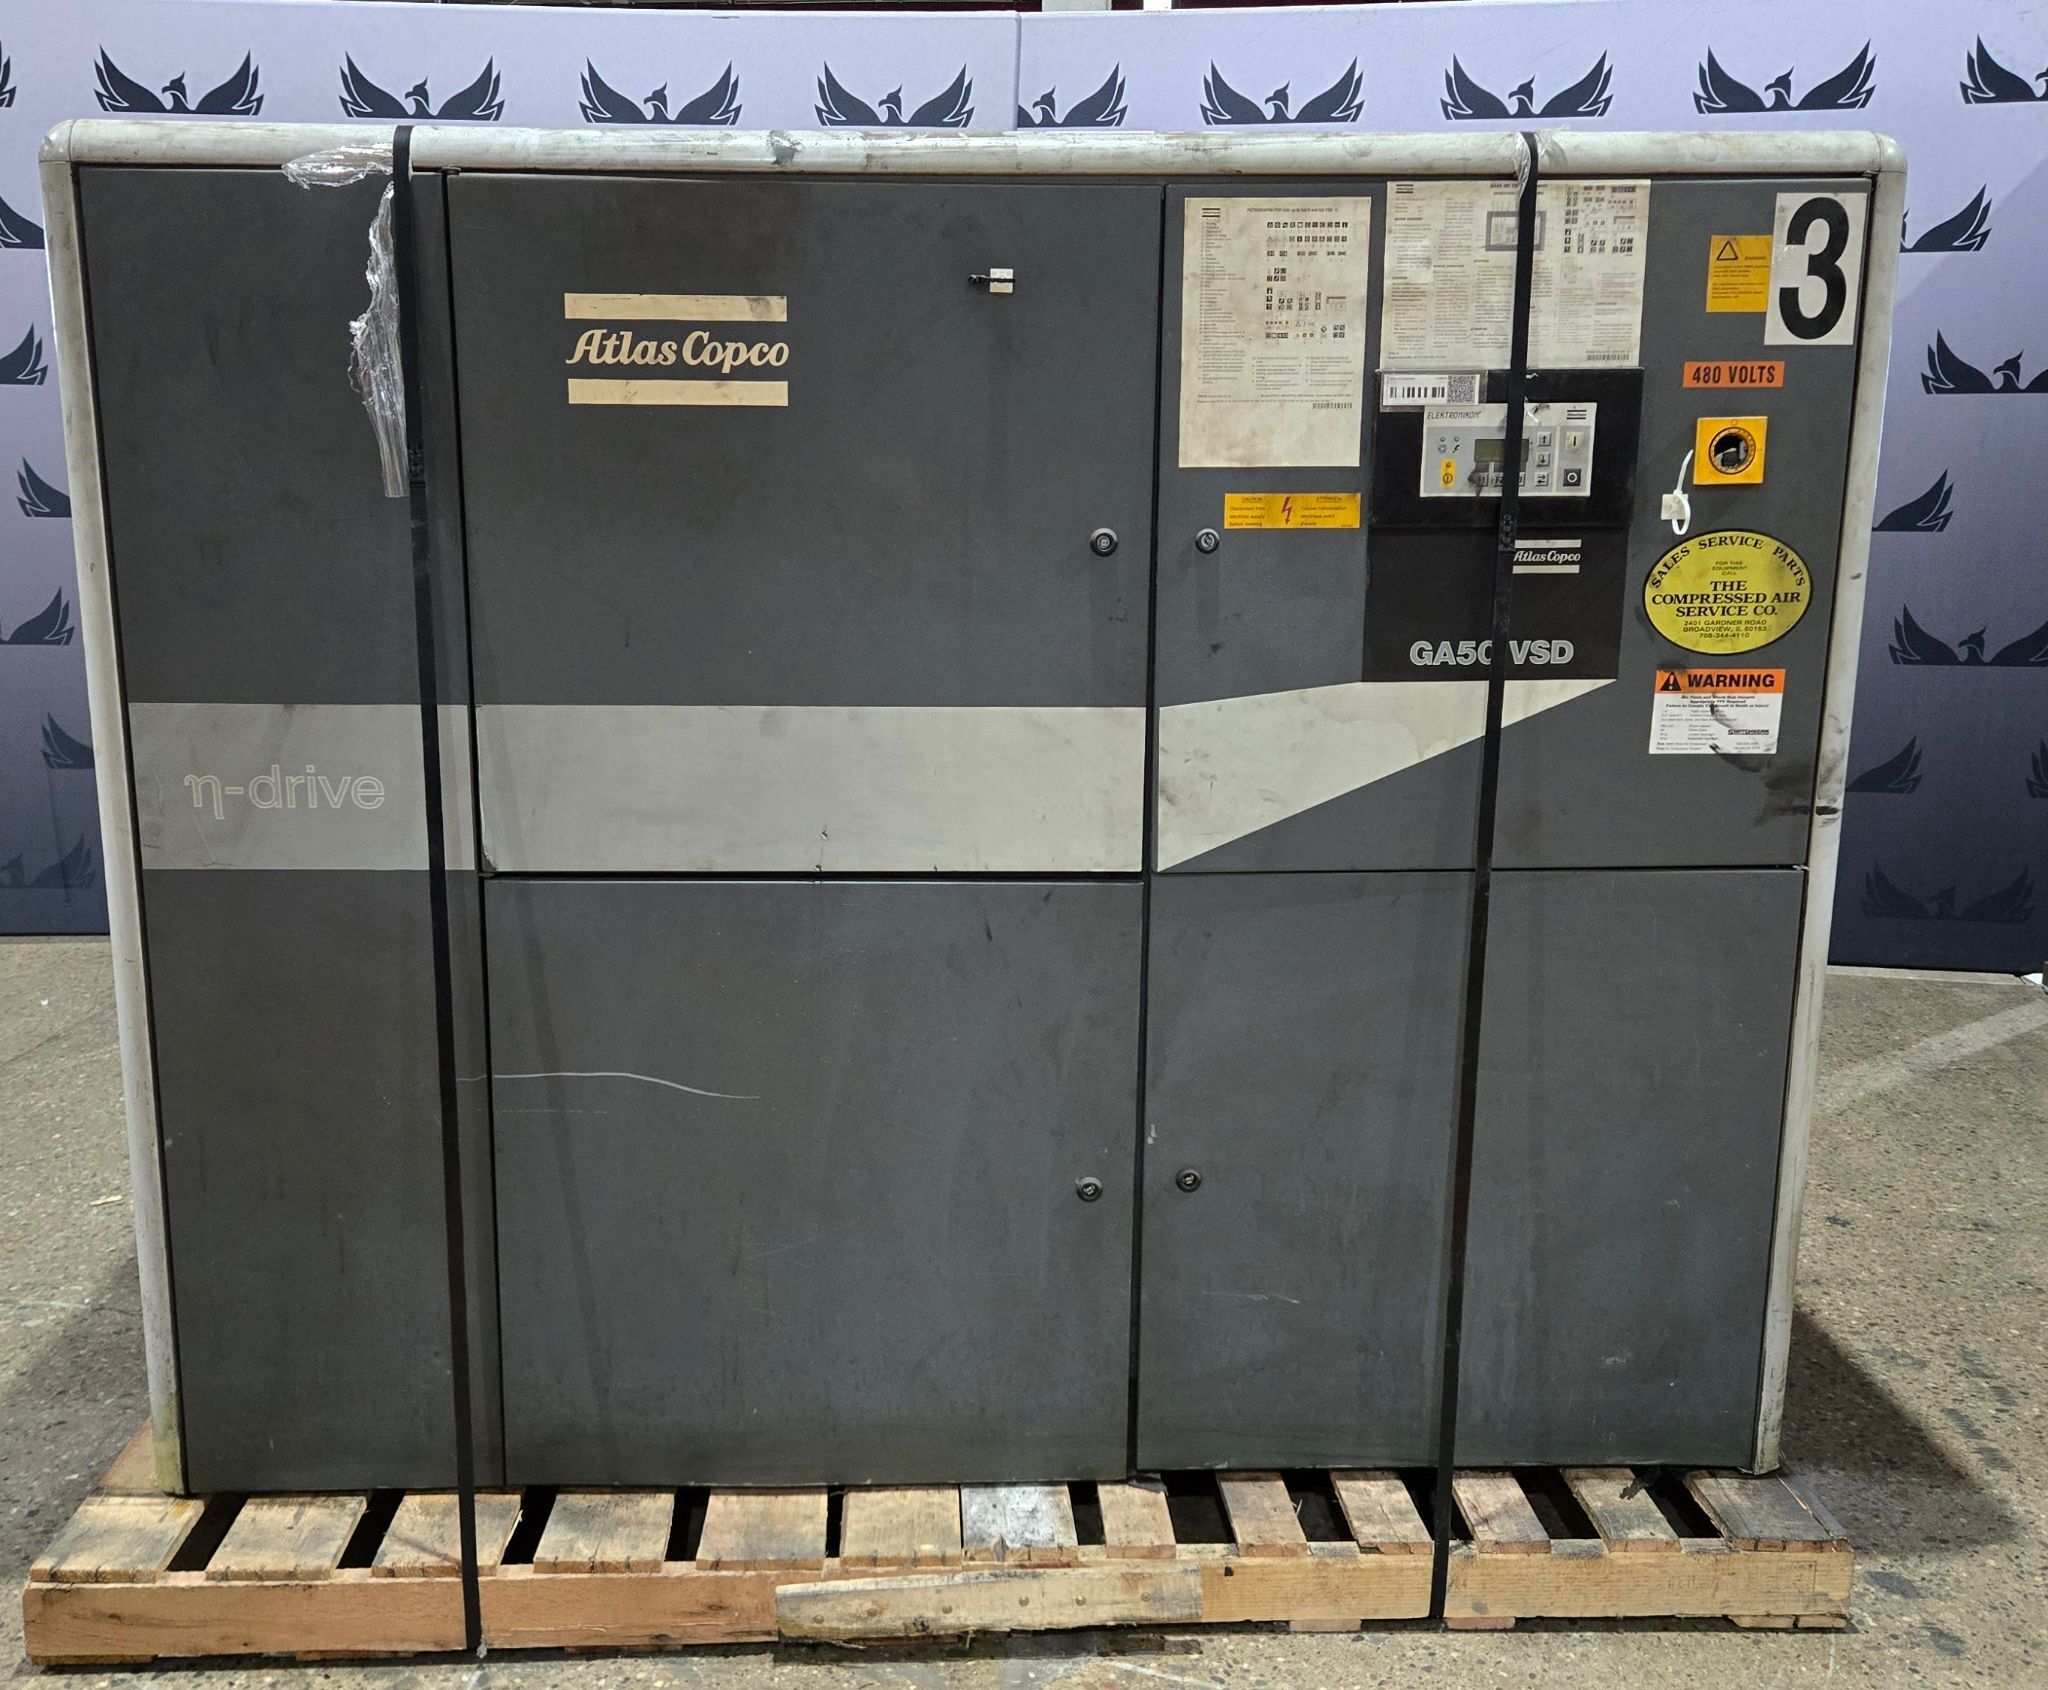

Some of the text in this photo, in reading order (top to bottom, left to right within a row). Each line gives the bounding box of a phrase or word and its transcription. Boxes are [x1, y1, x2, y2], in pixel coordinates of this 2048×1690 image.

[1779, 197, 1849, 340] 3
[565, 329, 790, 374] Atlas Copco
[1692, 365, 1776, 384] 480 VOLTS
[1513, 551, 1581, 563] Atlas Copco
[1651, 536, 1806, 588] SALES SERVICE PARTS
[1710, 580, 1748, 592] THE
[1652, 592, 1801, 605] COMPRESSED AIR
[1675, 605, 1778, 617] SERVICE CO.
[1508, 640, 1575, 665] VSD
[1687, 674, 1775, 687] WARNING
